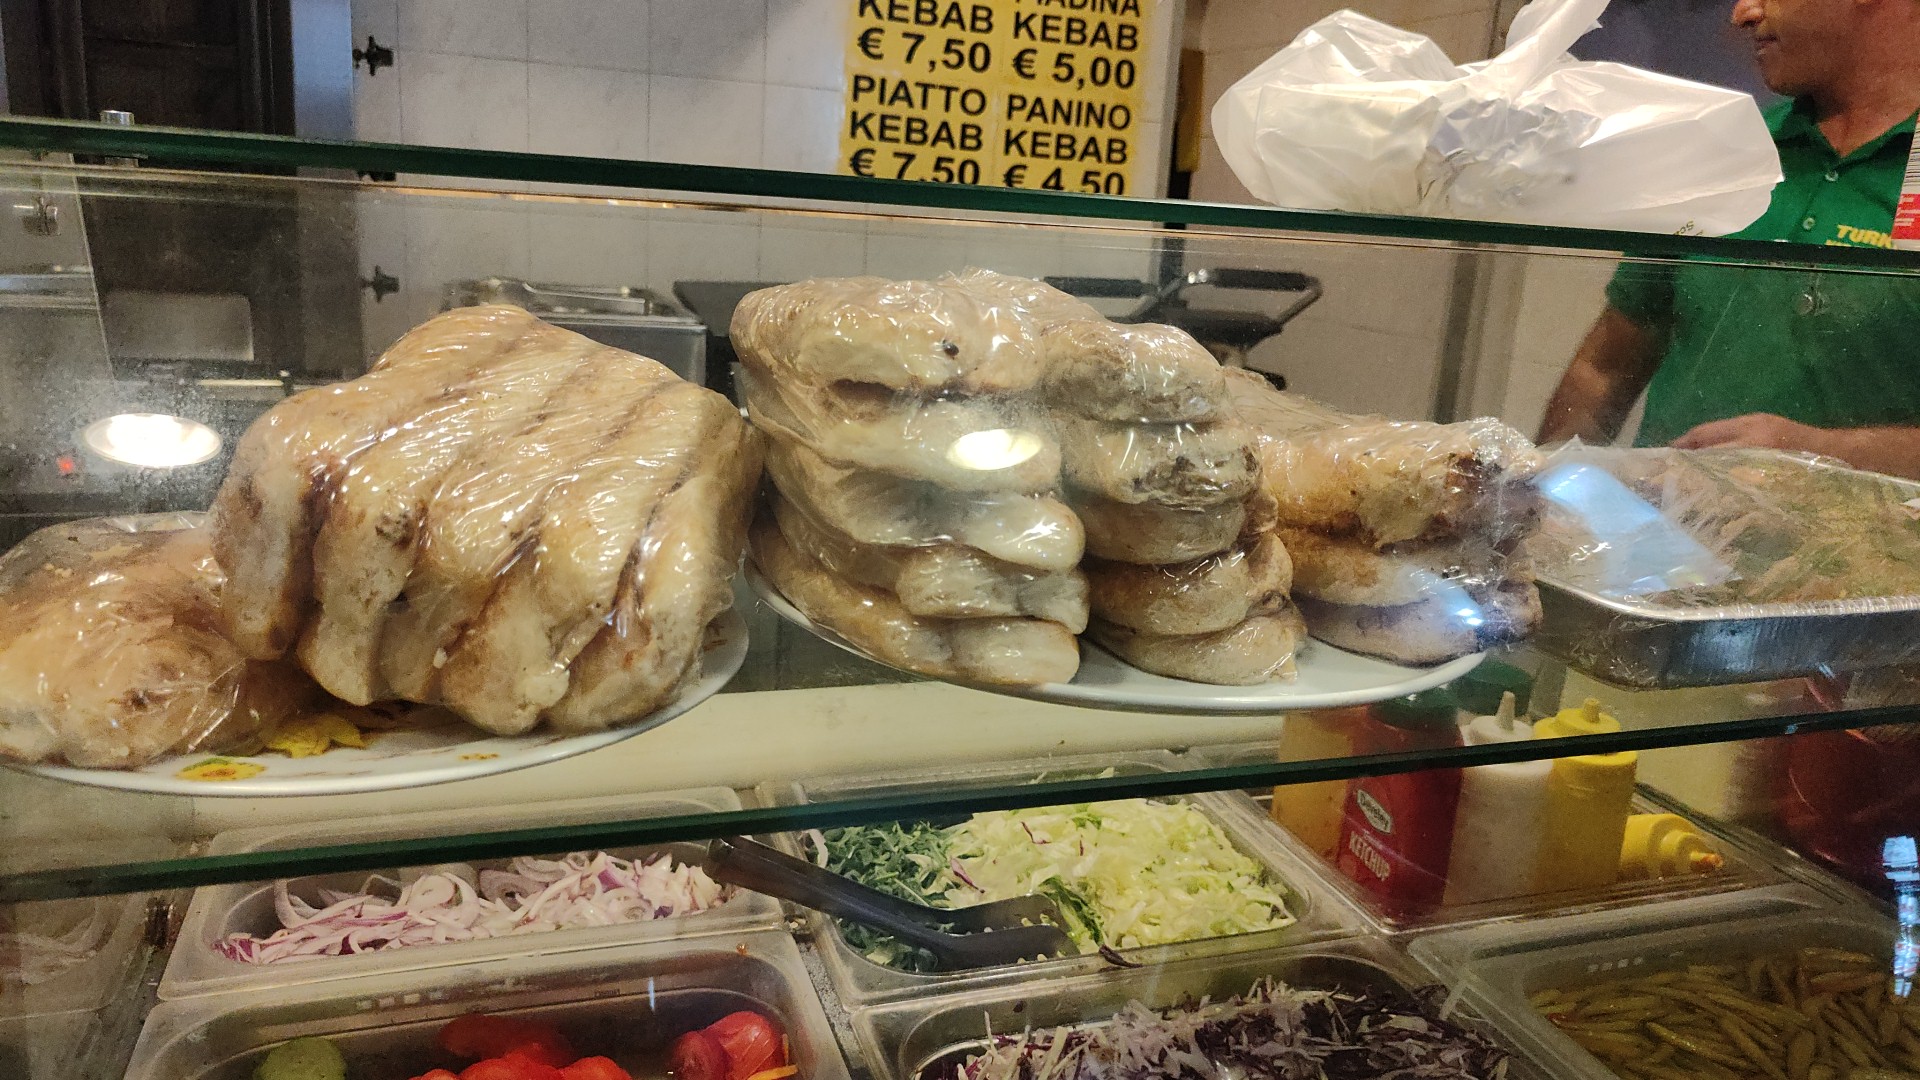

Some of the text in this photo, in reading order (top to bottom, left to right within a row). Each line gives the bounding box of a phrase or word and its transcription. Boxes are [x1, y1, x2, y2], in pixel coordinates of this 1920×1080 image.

[857, 0, 993, 34] KEBAB
[1013, 11, 1138, 51] KEBAB
[857, 27, 991, 73] € 7,50
[1012, 49, 1135, 90] € 5,00
[852, 75, 986, 116] PIATTO
[1007, 95, 1130, 130] PANINO
[850, 111, 983, 151] KEBAB
[1003, 129, 1127, 165] KEBAB
[849, 149, 876, 178] €
[1003, 164, 1124, 195] € 450
[1349, 830, 1391, 881] KETCHUP
